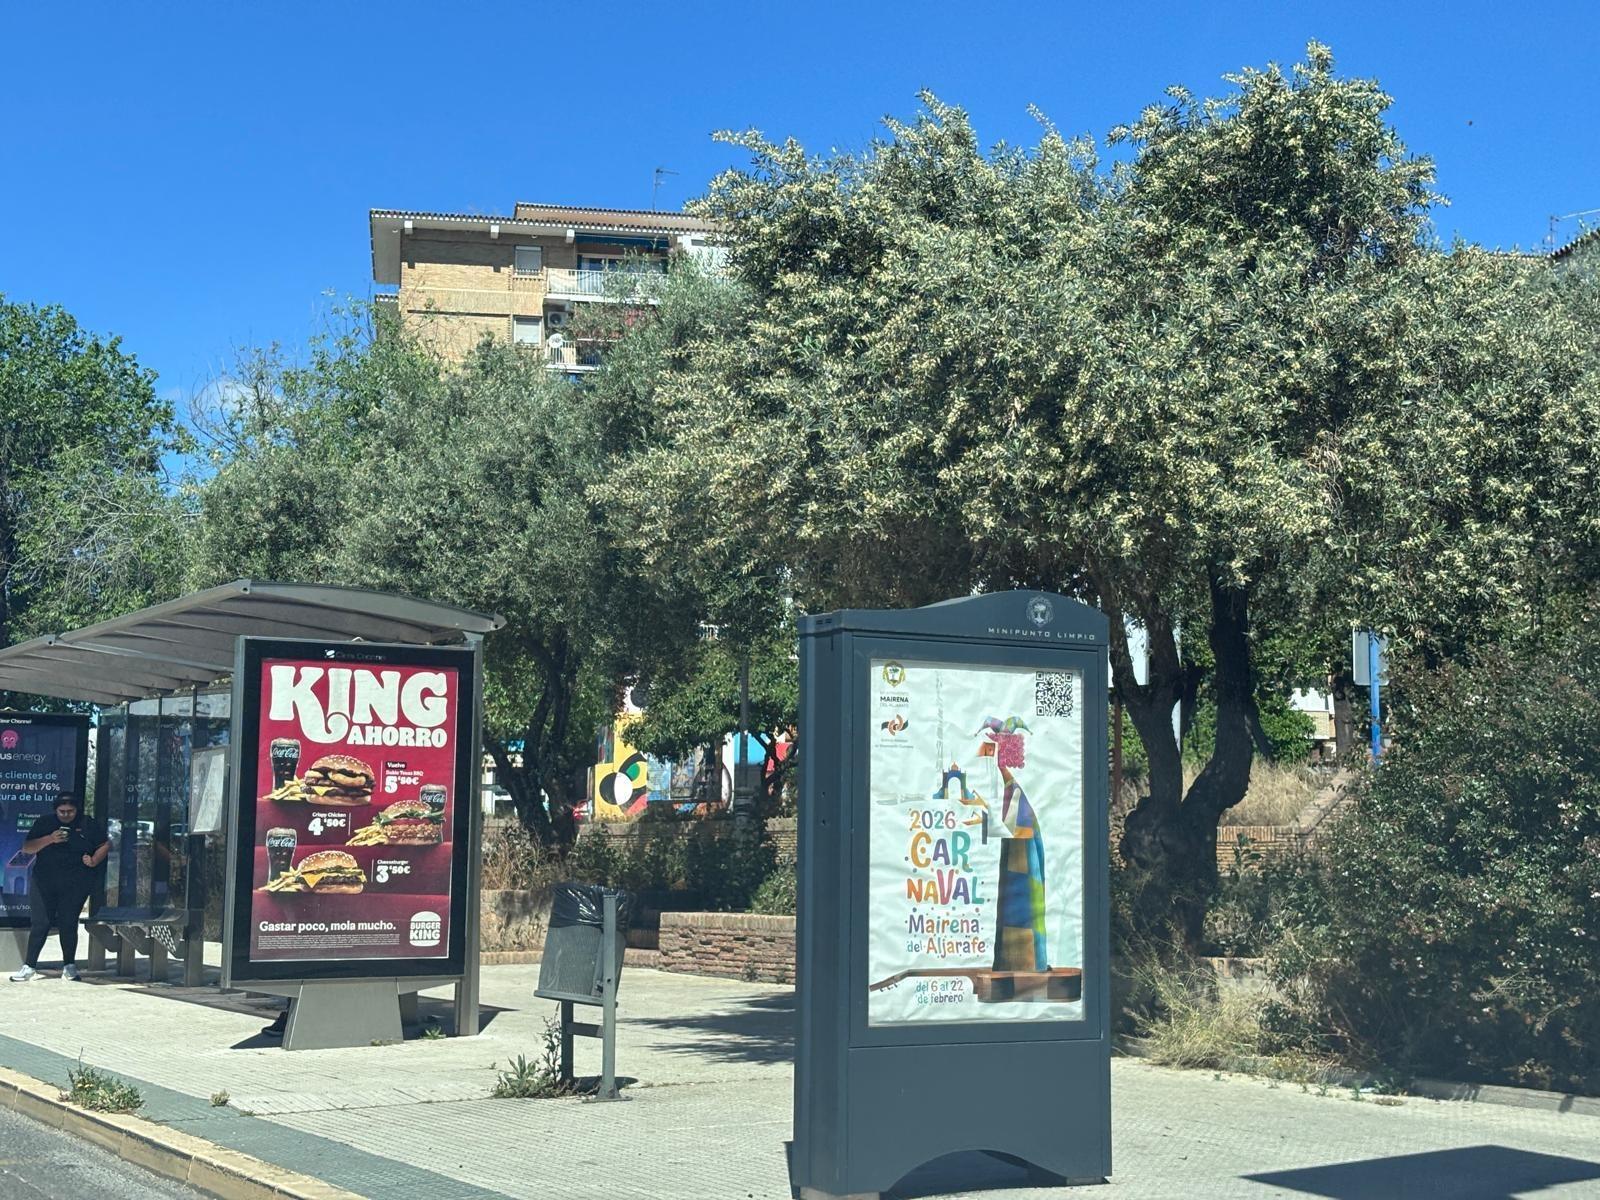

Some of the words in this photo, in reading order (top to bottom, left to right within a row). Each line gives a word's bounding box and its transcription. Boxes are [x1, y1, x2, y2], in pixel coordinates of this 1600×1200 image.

[988, 627, 1051, 638] MINIPUNTO
[1057, 632, 1095, 640] LIMPIO
[269, 665, 448, 744] KING
[347, 725, 448, 748] AHORRO
[5, 770, 43, 780] clientes
[45, 772, 58, 780] de
[28, 782, 39, 790] el
[40, 782, 61, 791] 76%
[19, 792, 32, 801] de
[33, 793, 43, 801] la
[307, 817, 347, 836] 4'50€
[910, 810, 956, 829] 2026
[910, 831, 974, 872] CAR
[376, 865, 411, 883] 3'50€
[907, 869, 985, 905] NAVAL
[259, 921, 297, 932] Gastar
[298, 922, 329, 933] poco,
[330, 920, 356, 931] mola
[357, 920, 397, 931] mucho.
[410, 922, 441, 930] BURGER
[908, 915, 980, 934] Mairena
[410, 930, 441, 940] KING
[907, 940, 922, 952] del
[926, 936, 986, 958] Aljarafe
[916, 982, 929, 992] del
[930, 981, 938, 992] 6
[940, 982, 948, 992] al
[950, 981, 964, 992] 22
[917, 994, 929, 1004] de
[931, 993, 964, 1004] febrero
